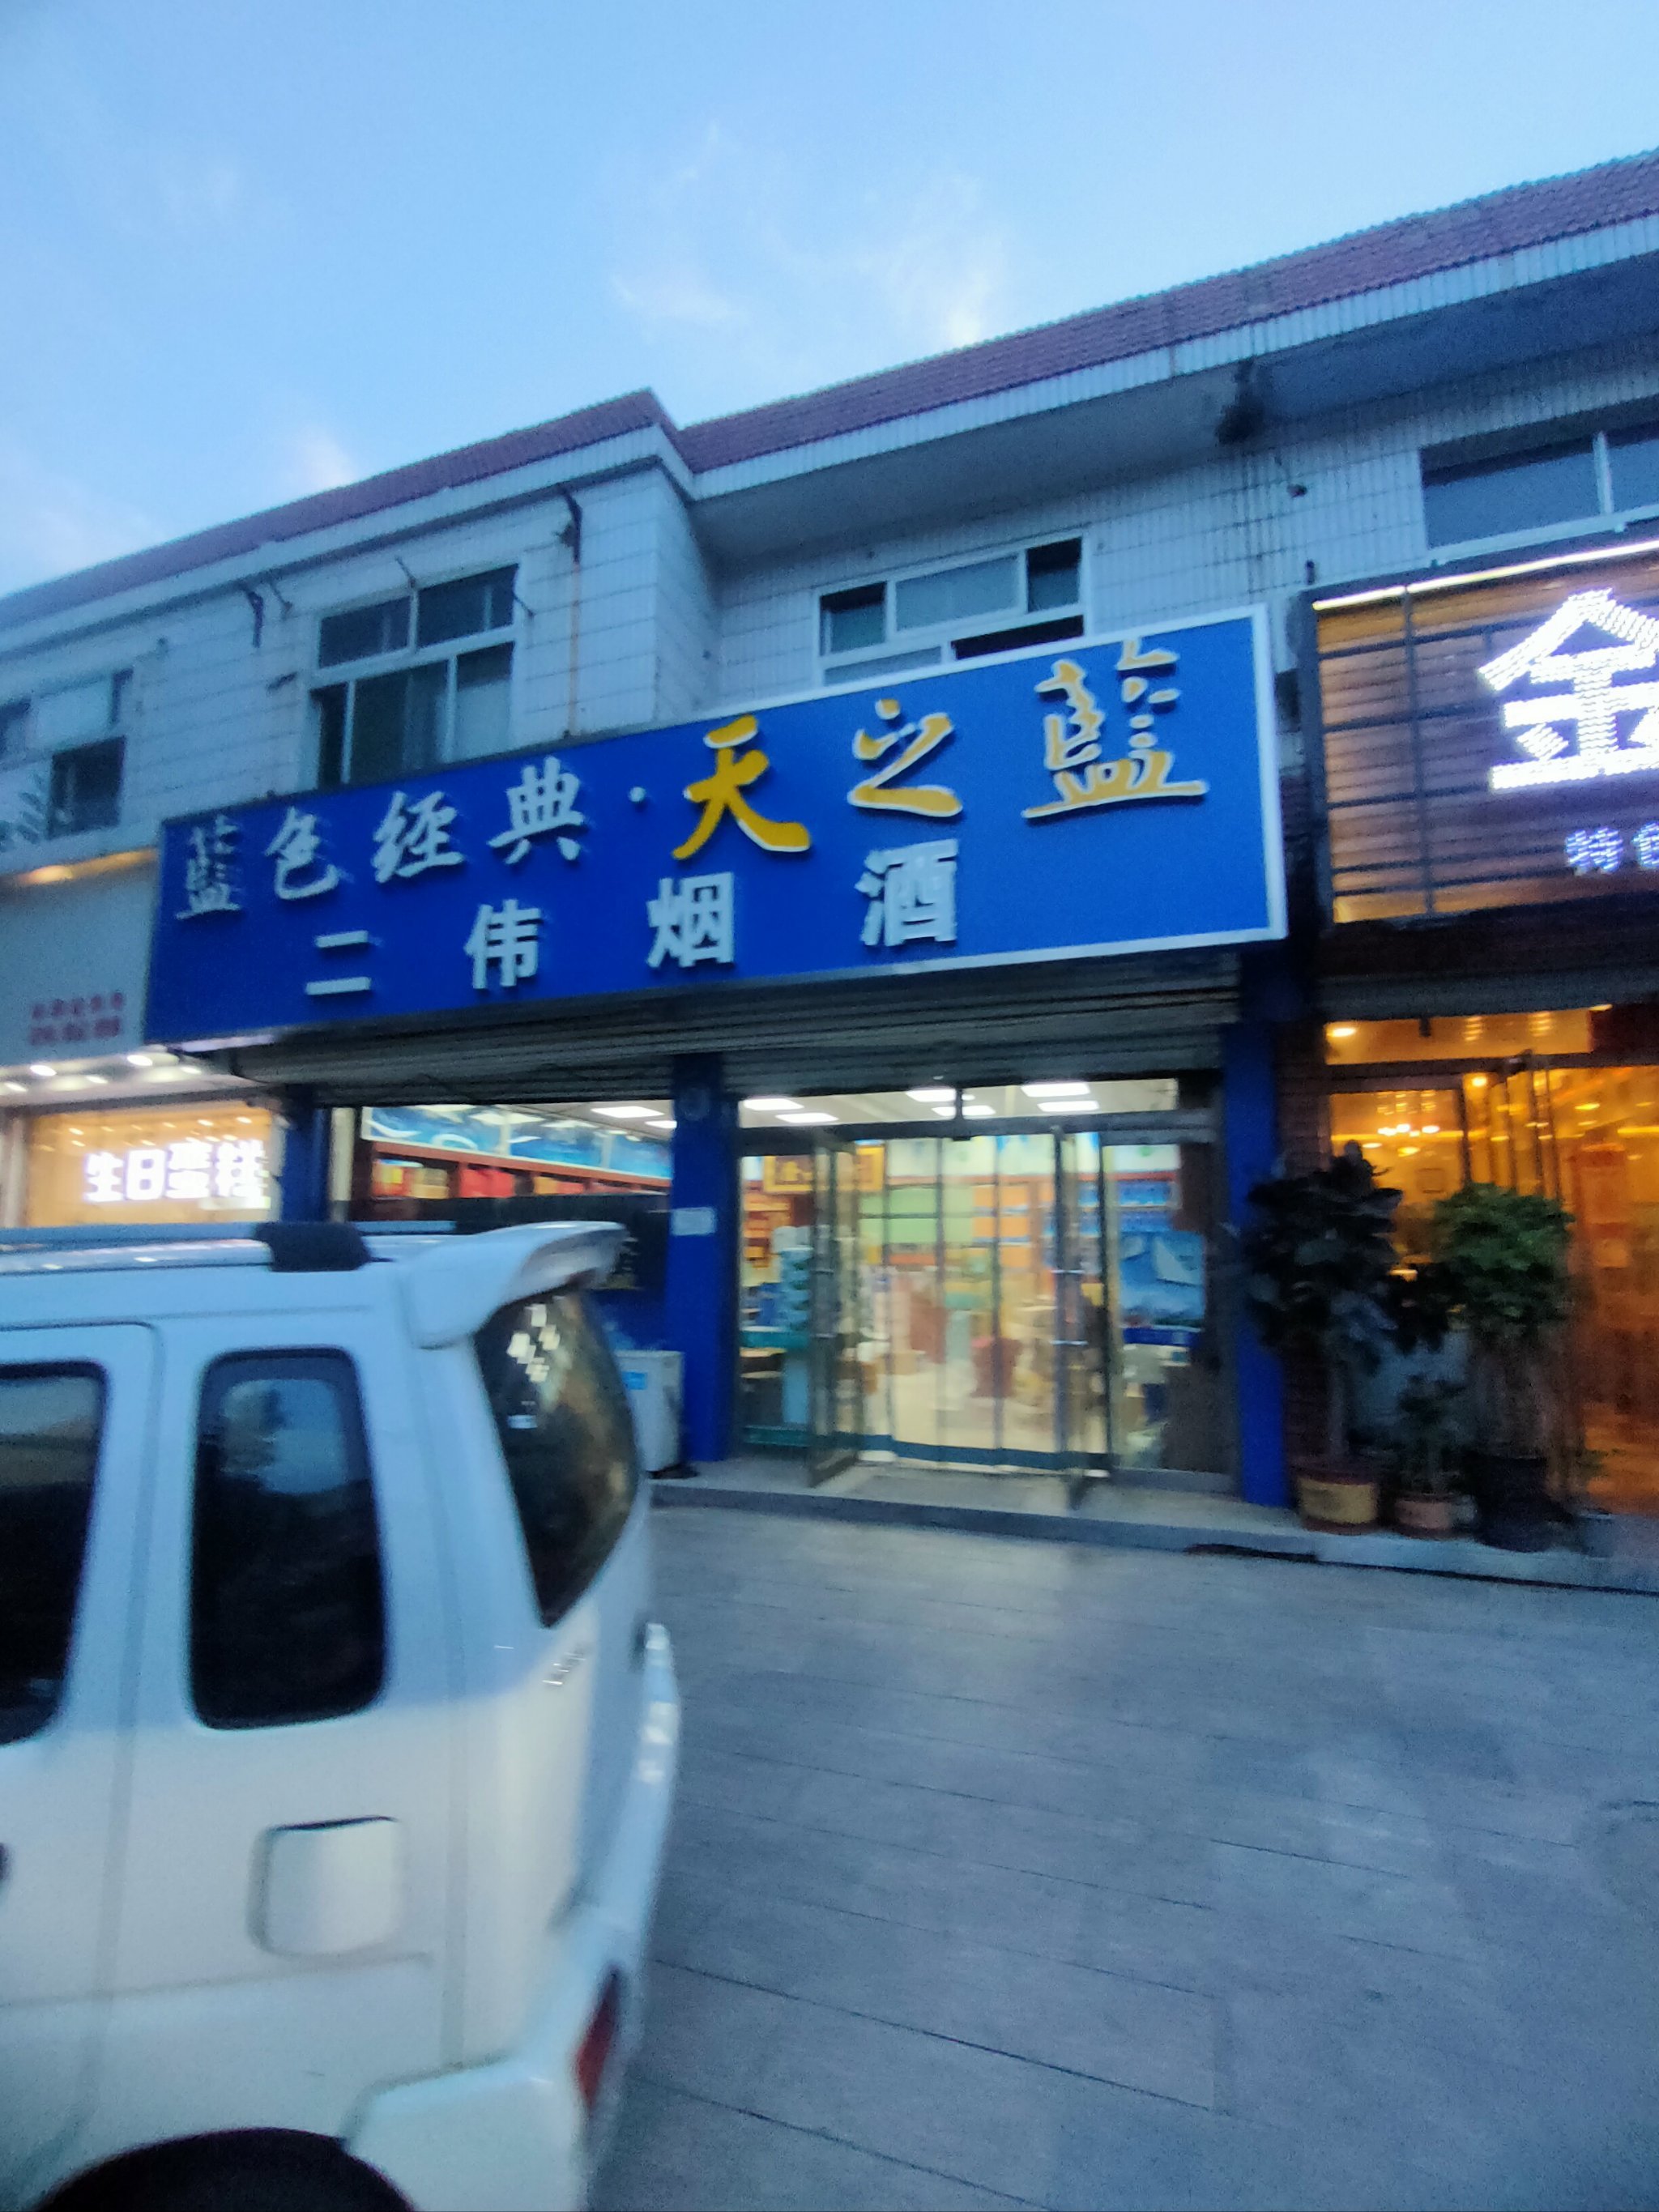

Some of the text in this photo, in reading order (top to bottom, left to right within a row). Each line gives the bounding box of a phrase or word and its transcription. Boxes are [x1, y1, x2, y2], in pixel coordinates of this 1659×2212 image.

[1478, 587, 1659, 791] 金
[305, 838, 958, 996] 二伟烟酒
